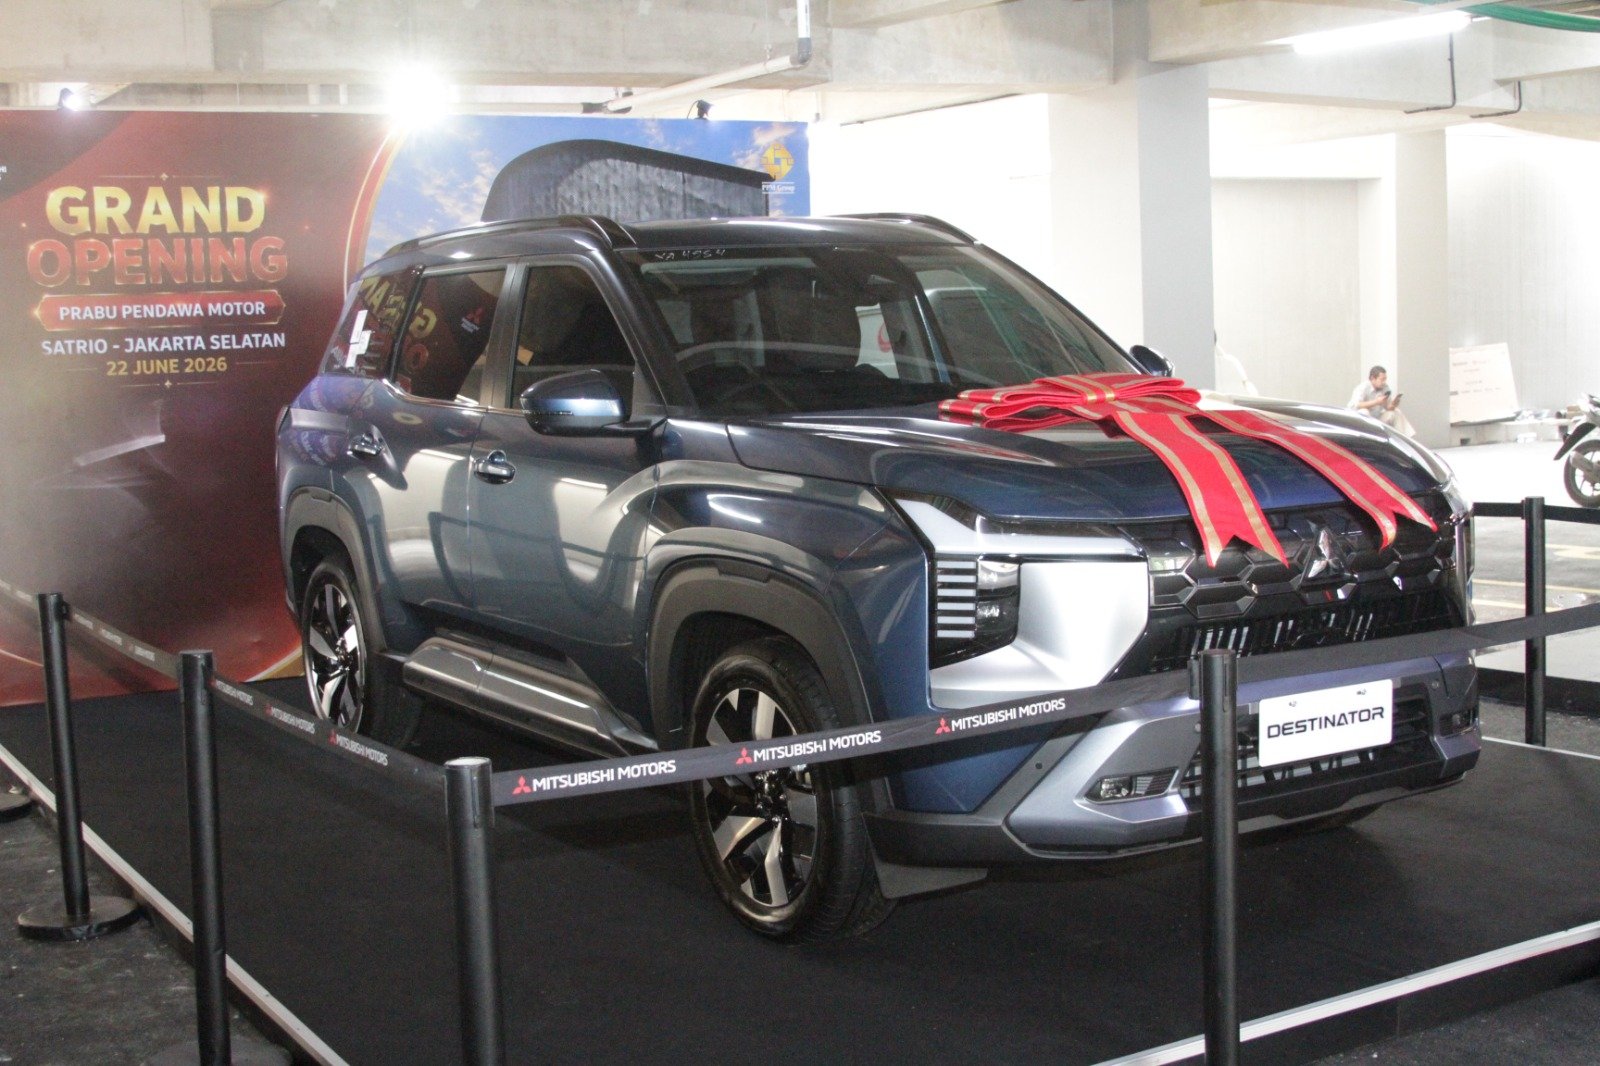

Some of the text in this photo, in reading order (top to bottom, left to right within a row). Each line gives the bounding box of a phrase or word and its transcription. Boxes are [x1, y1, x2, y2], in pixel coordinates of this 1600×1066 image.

[46, 186, 266, 235] GRAND
[27, 236, 288, 287] OPENING
[59, 301, 266, 320] PRABU PENDAWA MOTOR
[41, 338, 108, 356] SATRIO
[124, 335, 206, 353] JAKARTA
[210, 332, 286, 350] SELATAN
[106, 356, 228, 376] 22 JUNE 2026
[951, 698, 1066, 732] MITSUBISHI MOTORS
[1267, 706, 1385, 739] DESTINATOR
[753, 730, 882, 763] MITSUBISHI MOTORS
[532, 760, 677, 792] MITSUBISHI MOTORS
